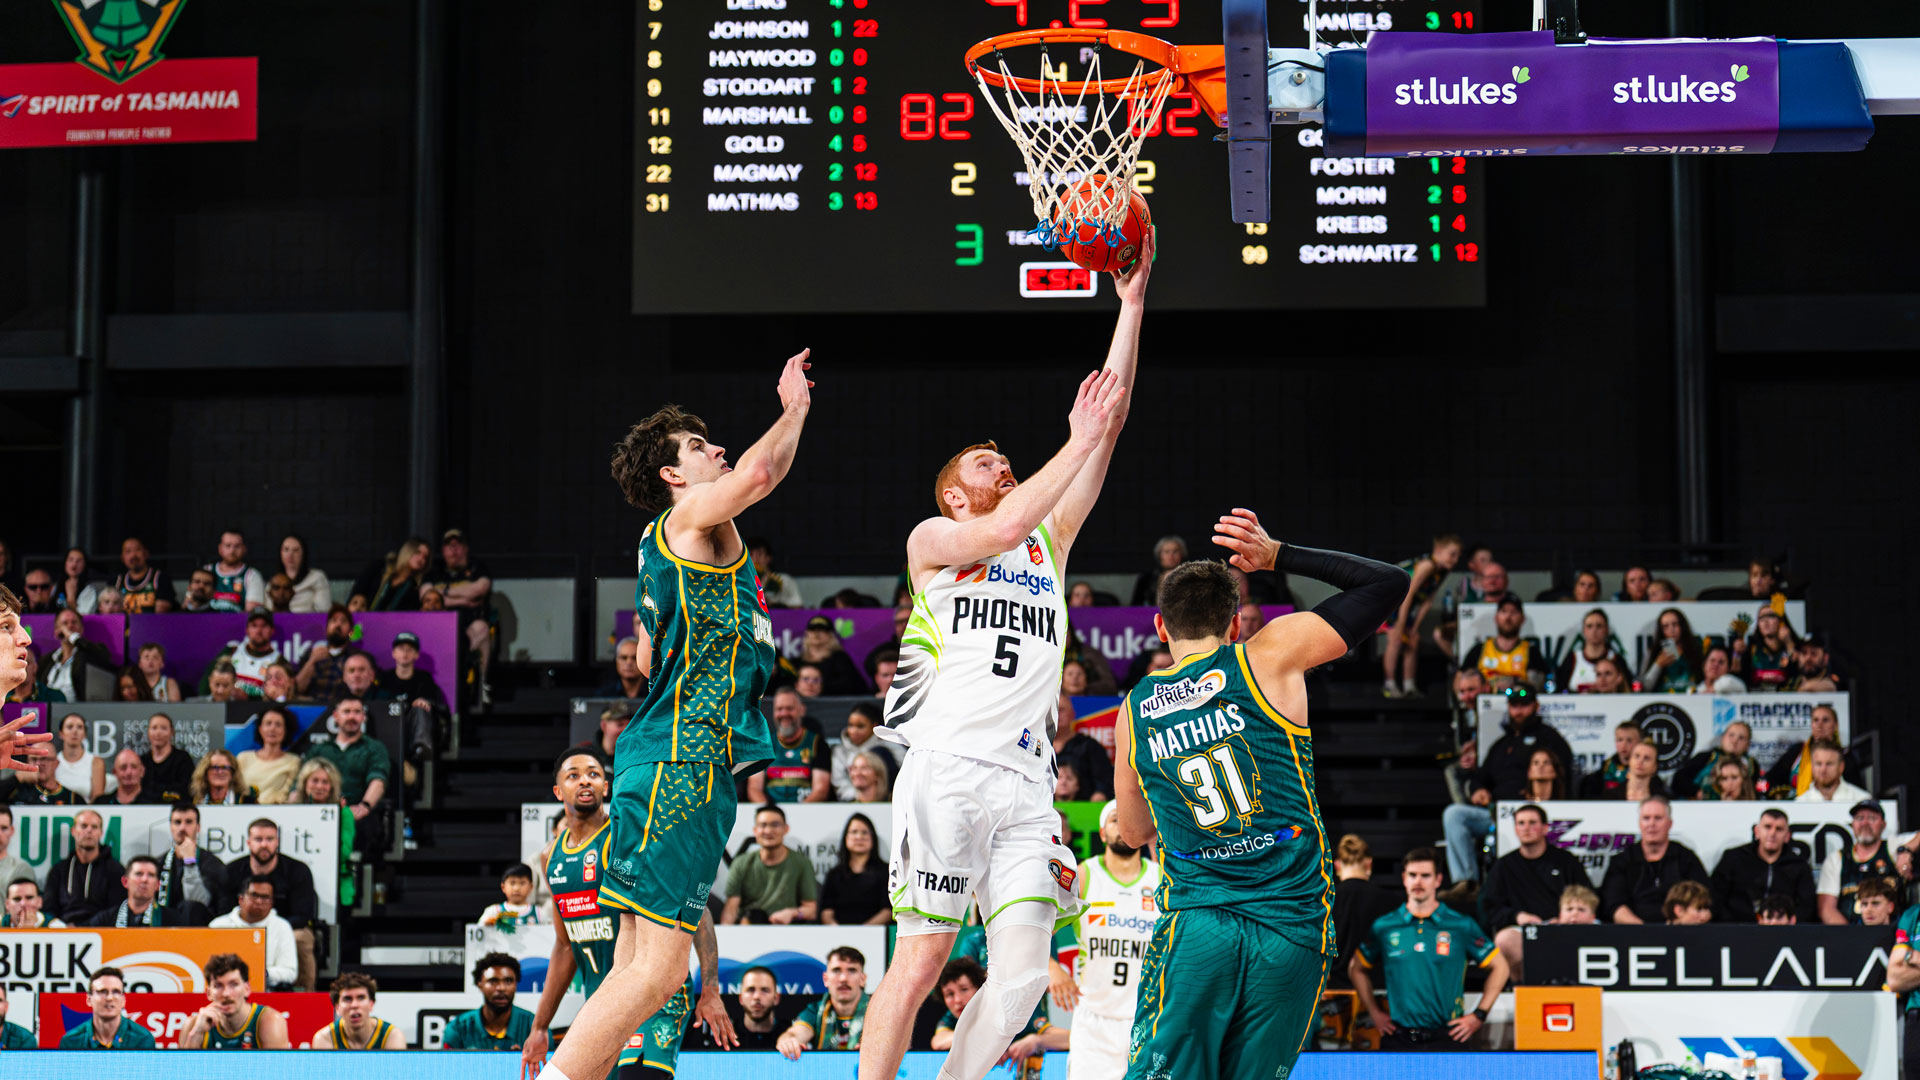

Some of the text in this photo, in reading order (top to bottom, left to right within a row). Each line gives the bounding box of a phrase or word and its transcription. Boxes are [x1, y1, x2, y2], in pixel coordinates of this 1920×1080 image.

[648, 19, 879, 40] 7 JOHNSON 1 22
[1426, 11, 1440, 30] 3
[1452, 11, 1473, 29] 11
[647, 48, 868, 69] 8 HAYWOOD 0 0
[647, 77, 868, 97] 9 STODDART 1 2
[1395, 76, 1518, 106] st.lukes
[1613, 74, 1738, 104] st.lukes
[28, 90, 240, 115] SPIRIT of TASMANIA
[648, 107, 670, 125] 11
[703, 106, 813, 126] MARSHALL
[829, 106, 844, 124] 0
[901, 93, 974, 140] 82
[647, 134, 868, 154] 12 GOLD 4 5
[646, 163, 878, 183] 22 MAGNAY 2 12
[1310, 157, 1466, 175] FOSTER 1 2
[951, 162, 977, 196] 2
[646, 191, 878, 212] 31 MATHIAS 3 13
[1316, 186, 1387, 205] MORIN
[1427, 185, 1442, 204] 2
[1316, 215, 1388, 234] KREBS
[1429, 214, 1440, 232] 1
[1452, 214, 1466, 232] 4
[955, 224, 983, 266] 3
[1242, 242, 1478, 265] 99 SCHWARTZ 1 12
[988, 563, 1056, 596] Budget
[952, 596, 1058, 647] PHOENIX
[992, 634, 1021, 679] 5
[174, 720, 210, 732] AILEY
[1147, 704, 1246, 763] MATHIAS
[1178, 744, 1254, 829] 31
[320, 809, 336, 821] 21
[524, 807, 539, 820] 22
[1200, 833, 1275, 859] logistics
[567, 902, 596, 913] TASMANIA
[1108, 913, 1154, 933] Budge
[1525, 925, 1538, 940] 12
[469, 928, 484, 941] 10
[1090, 937, 1149, 960] PHOENI
[582, 946, 599, 974] 1
[1113, 961, 1129, 987] 9
